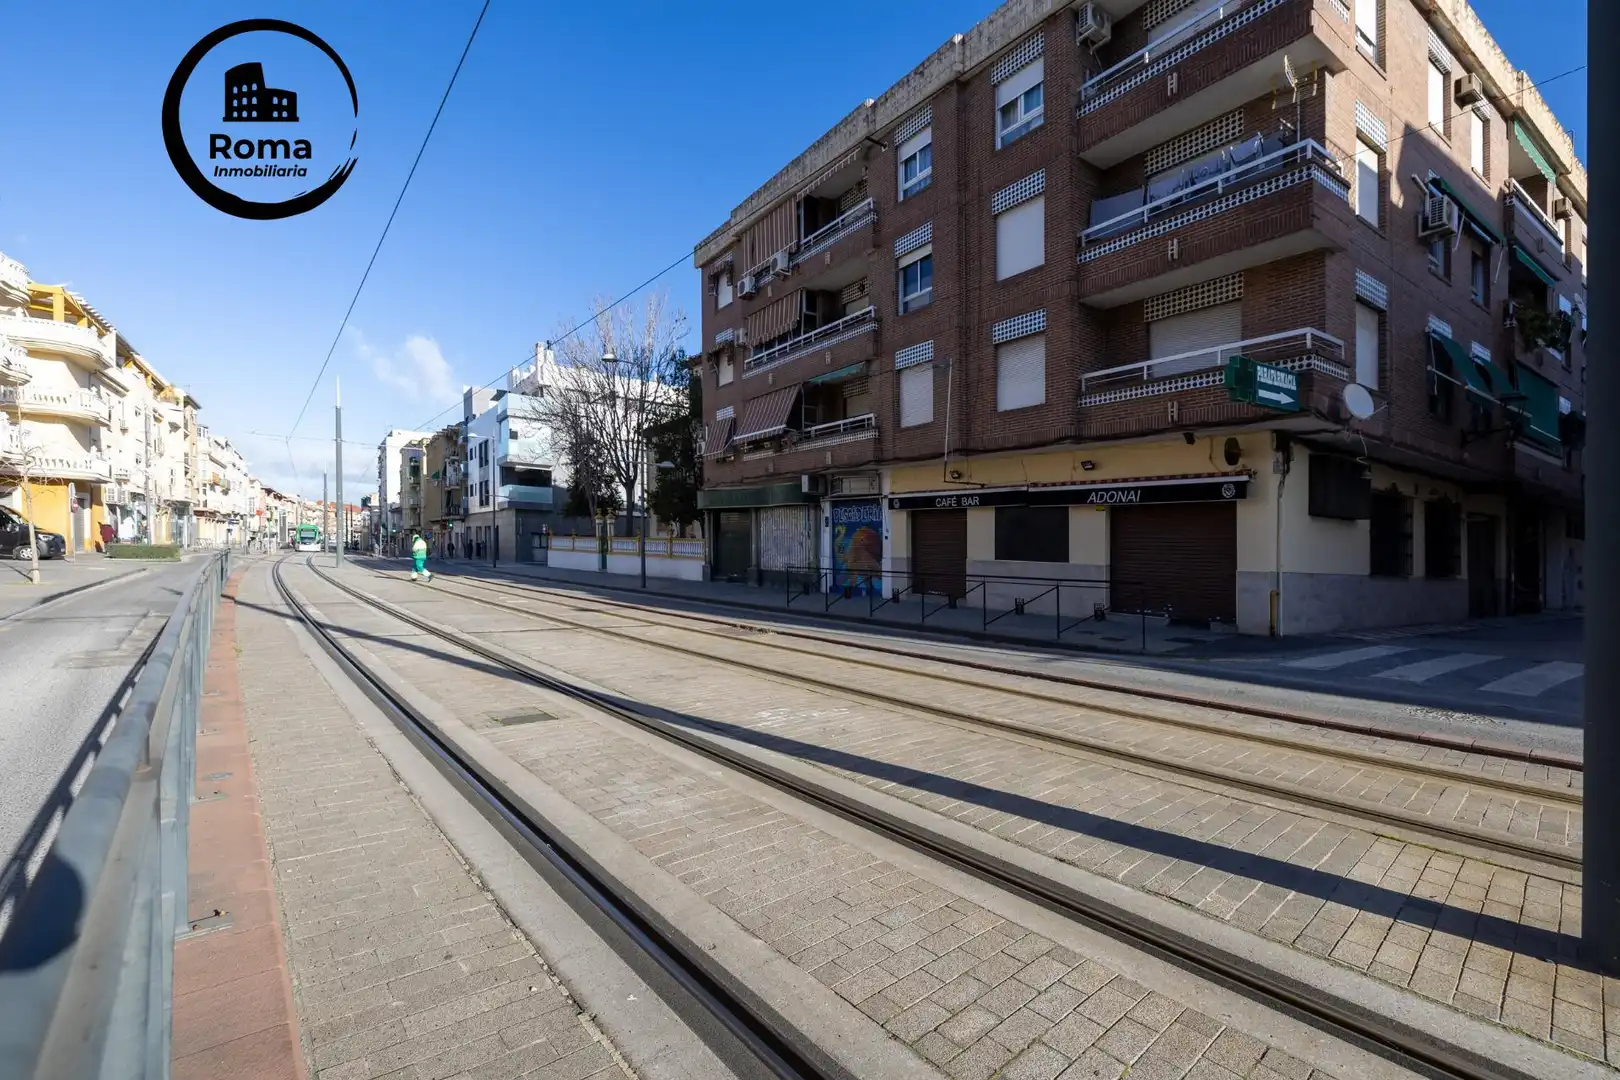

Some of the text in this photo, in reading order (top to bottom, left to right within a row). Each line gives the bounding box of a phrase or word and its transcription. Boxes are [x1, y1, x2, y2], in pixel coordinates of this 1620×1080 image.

[935, 496, 980, 507] CAFÉ BAR
[1086, 490, 1141, 504] ADONAI
